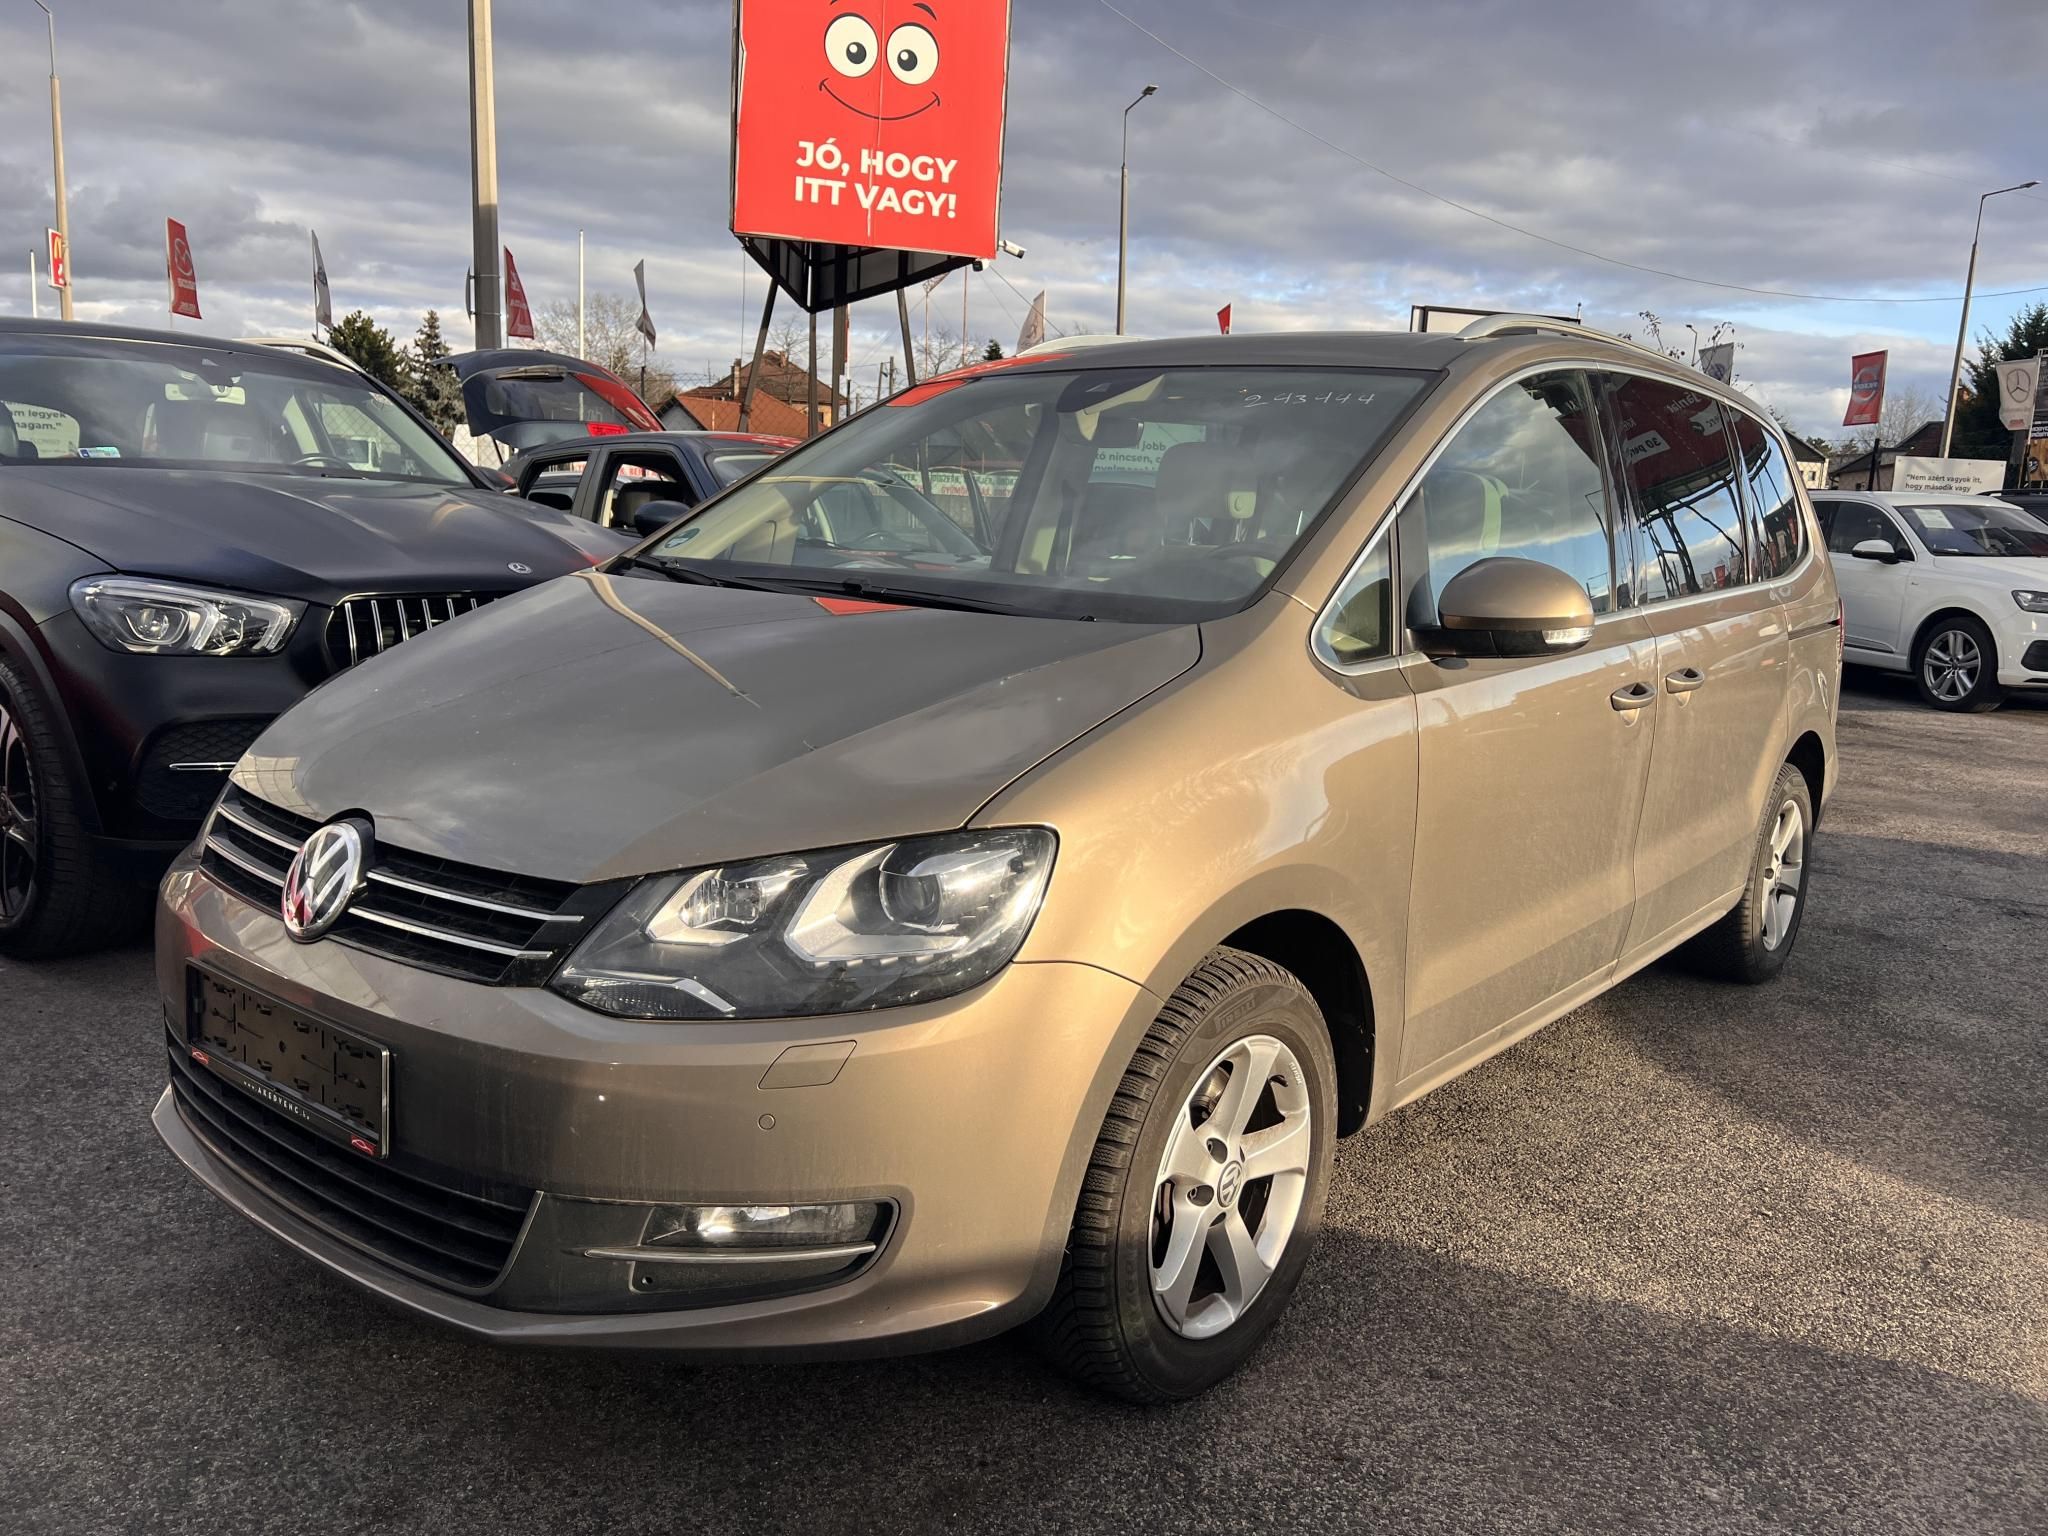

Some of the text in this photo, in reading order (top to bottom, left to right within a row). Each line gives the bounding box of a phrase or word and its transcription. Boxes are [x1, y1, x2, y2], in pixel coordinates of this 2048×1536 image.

[796, 137, 958, 184] JÓ, HOGY
[795, 175, 957, 219] ITT VAGY!
[1905, 482, 1971, 493] hogy második vagy
[1946, 476, 1971, 484] vagyok
